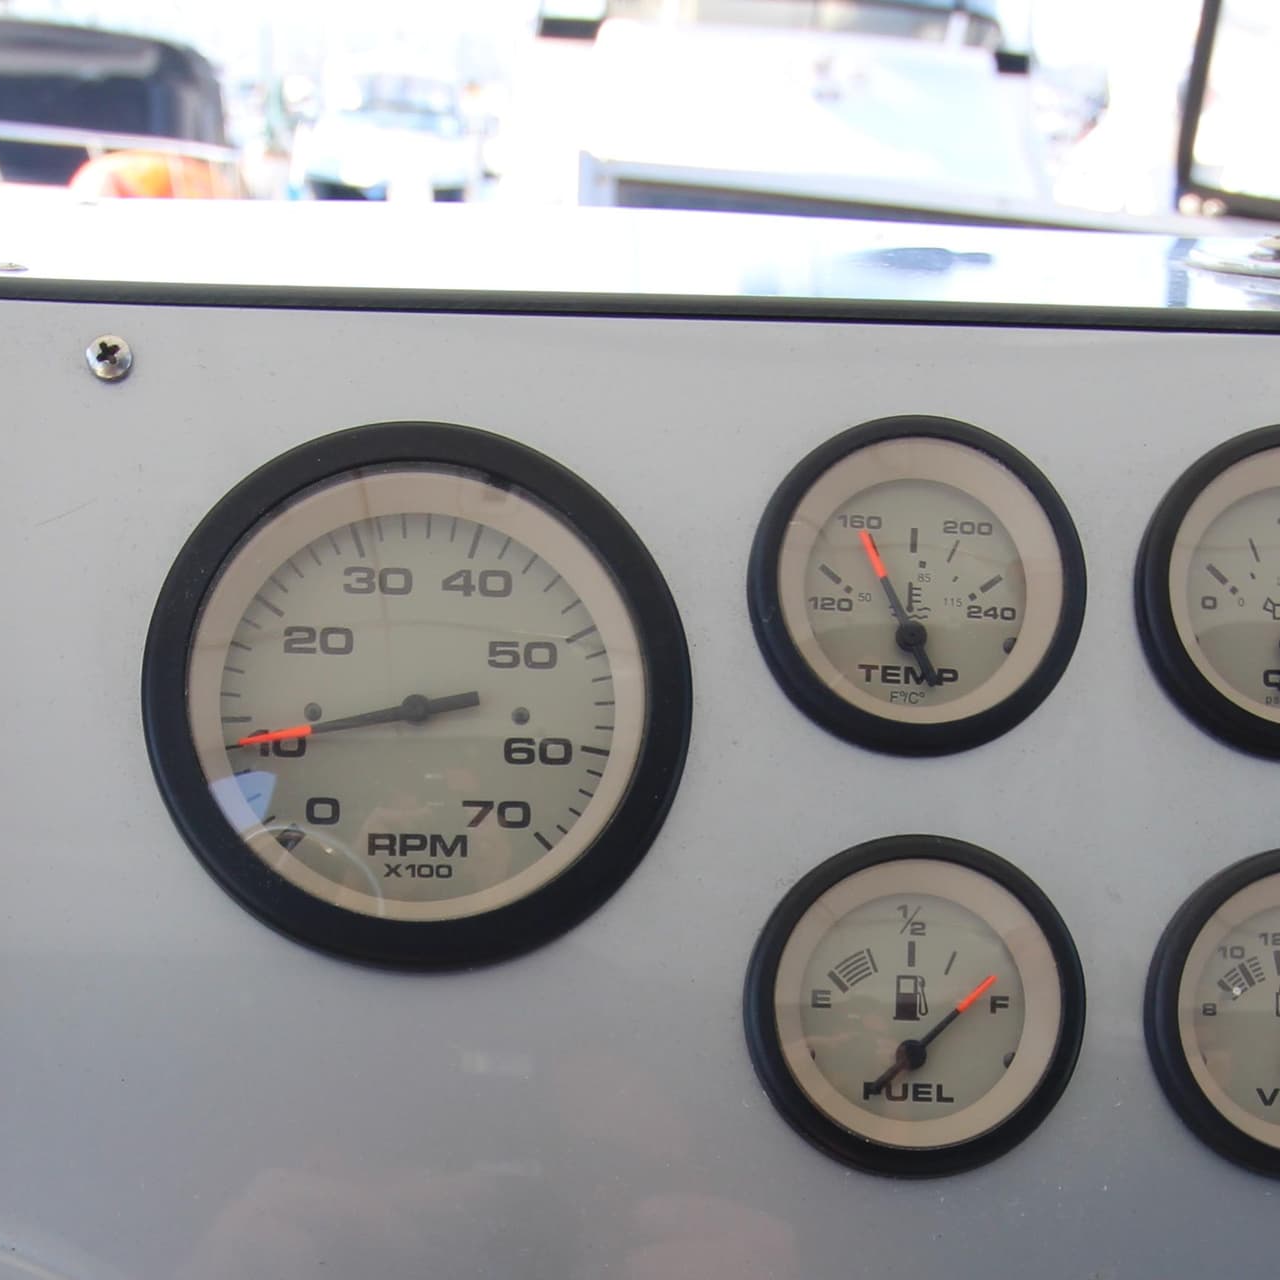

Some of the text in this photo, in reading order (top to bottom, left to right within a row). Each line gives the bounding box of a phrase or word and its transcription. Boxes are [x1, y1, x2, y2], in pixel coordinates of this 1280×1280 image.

[838, 514, 882, 530] 160
[943, 520, 993, 536] 200
[342, 566, 414, 596] 30
[441, 569, 513, 598] 40
[808, 596, 853, 612] 120
[858, 592, 872, 602] 50
[944, 597, 963, 607] 115
[1201, 596, 1217, 610] 0
[966, 605, 1016, 621] 240
[283, 626, 354, 655] 20
[487, 641, 558, 670] 50
[857, 663, 959, 687] TEMP
[504, 737, 572, 766] 60
[306, 797, 340, 826] 0
[461, 800, 531, 829] 70
[367, 833, 468, 858] RPM
[384, 863, 453, 879] X100
[1218, 946, 1245, 959] 10
[812, 989, 832, 1009] E
[991, 996, 1009, 1014] F
[1202, 1003, 1217, 1016] 8
[863, 1082, 954, 1103] FUEL
